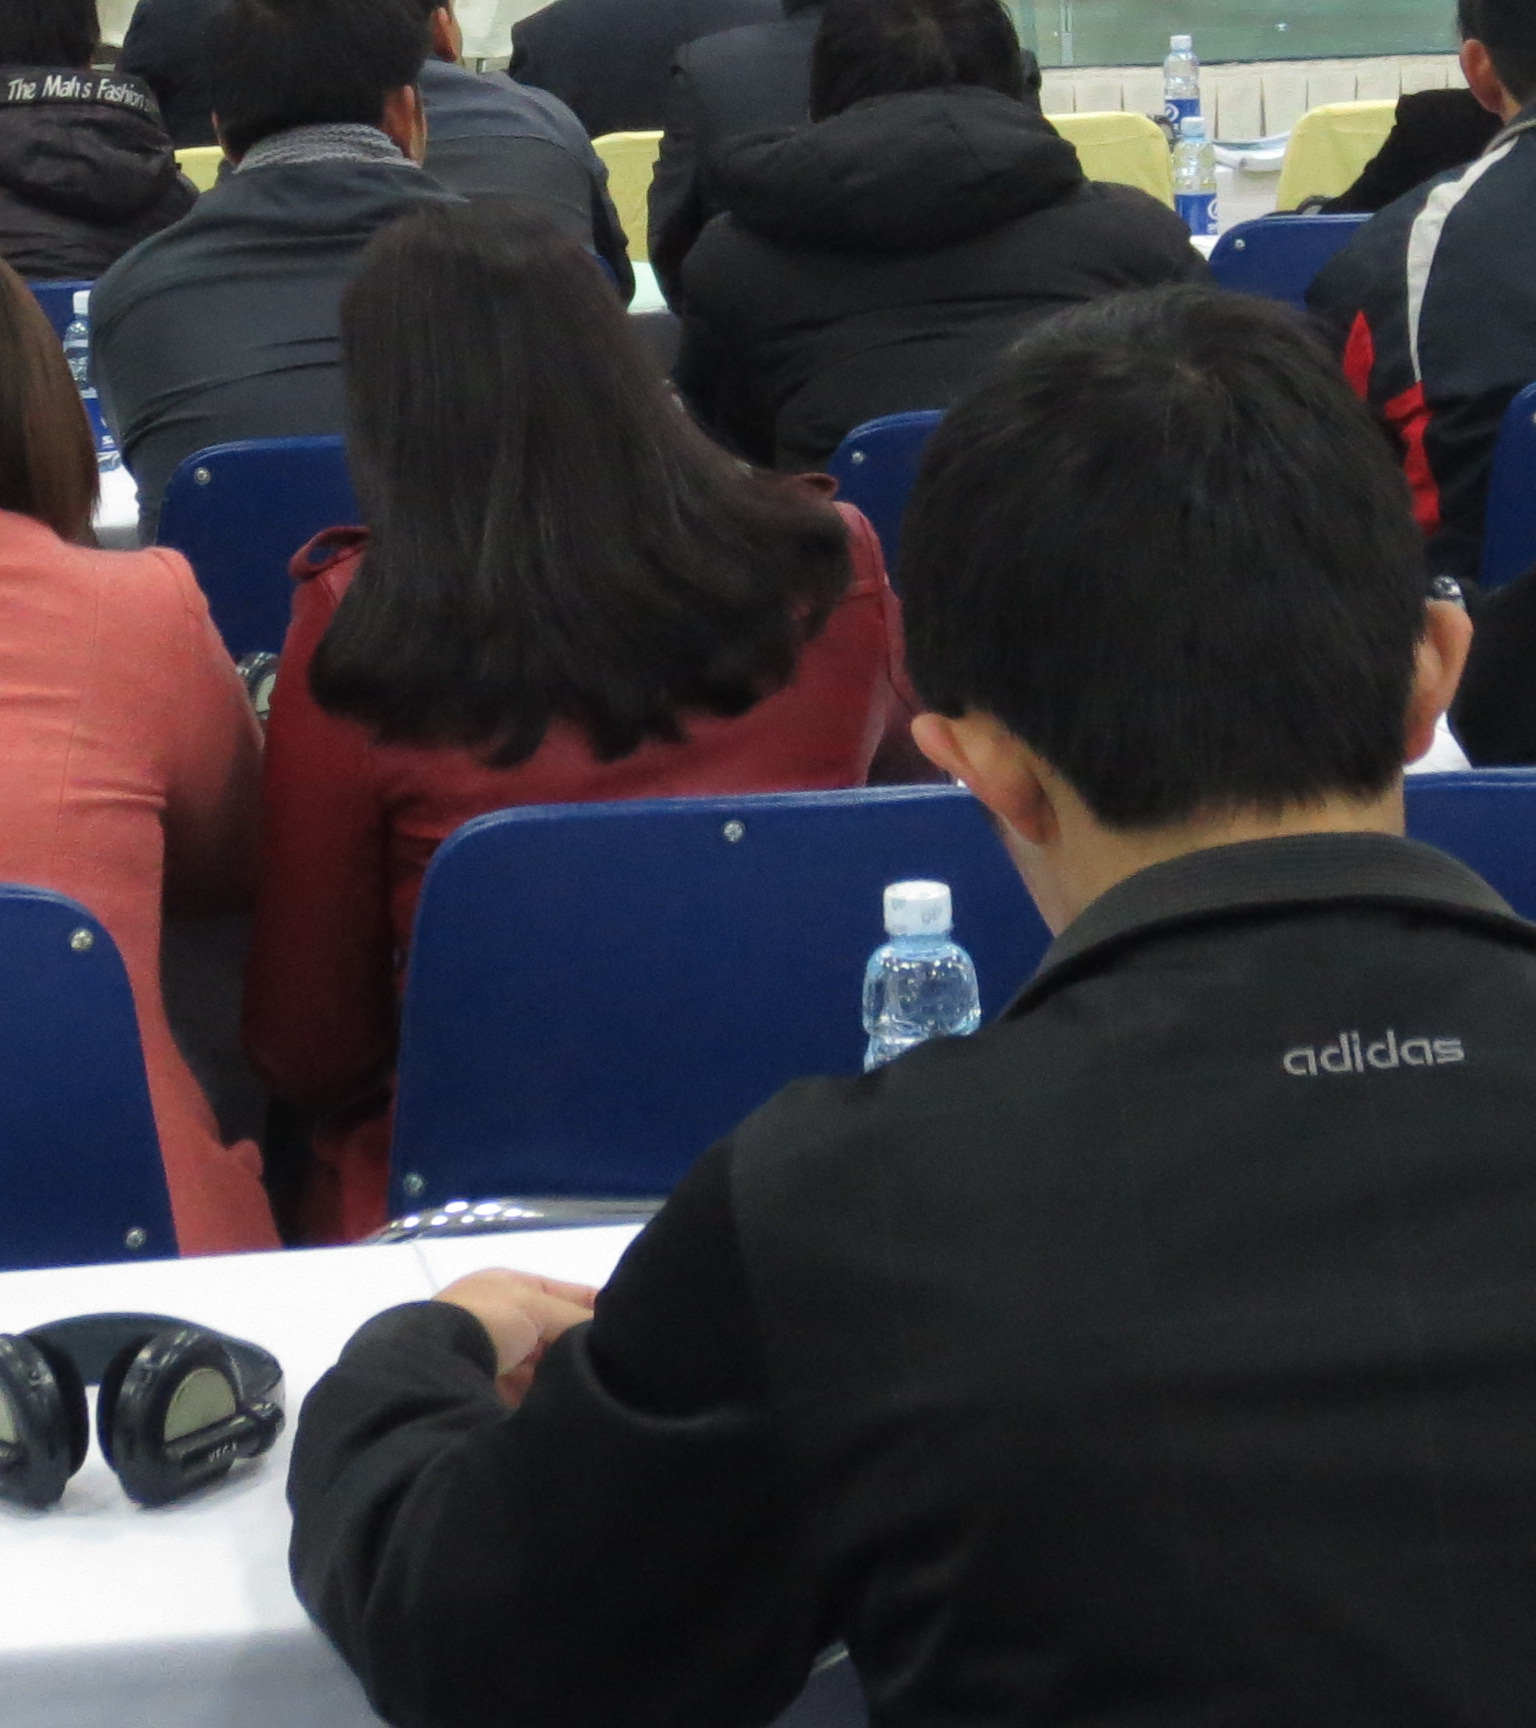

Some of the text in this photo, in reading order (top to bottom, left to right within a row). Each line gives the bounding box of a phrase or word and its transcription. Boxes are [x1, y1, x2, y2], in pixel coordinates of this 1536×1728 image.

[7, 77, 37, 101] The
[96, 78, 146, 110] Fashion
[1282, 1028, 1466, 1076] adidas
